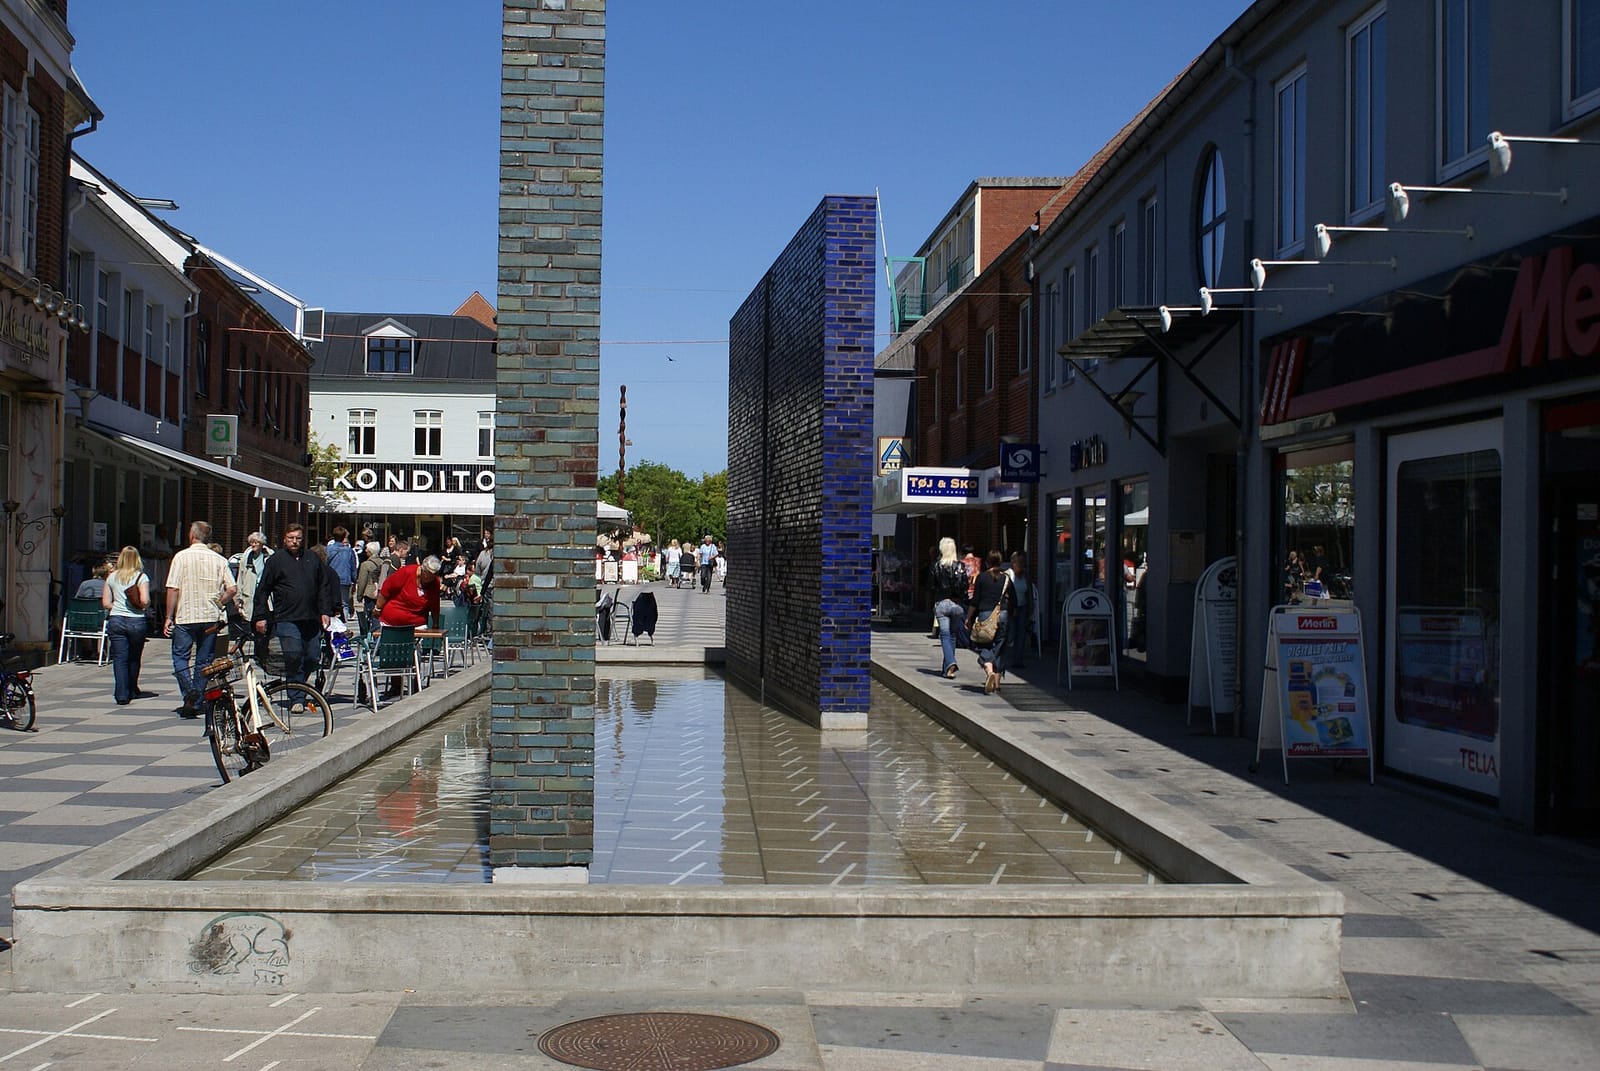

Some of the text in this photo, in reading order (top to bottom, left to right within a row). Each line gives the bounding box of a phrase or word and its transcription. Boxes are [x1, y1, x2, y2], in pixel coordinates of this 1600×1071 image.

[333, 468, 496, 492] KONDITO
[937, 480, 946, 488] &
[1300, 618, 1335, 628] Merlin
[1459, 747, 1498, 779] TELIA
